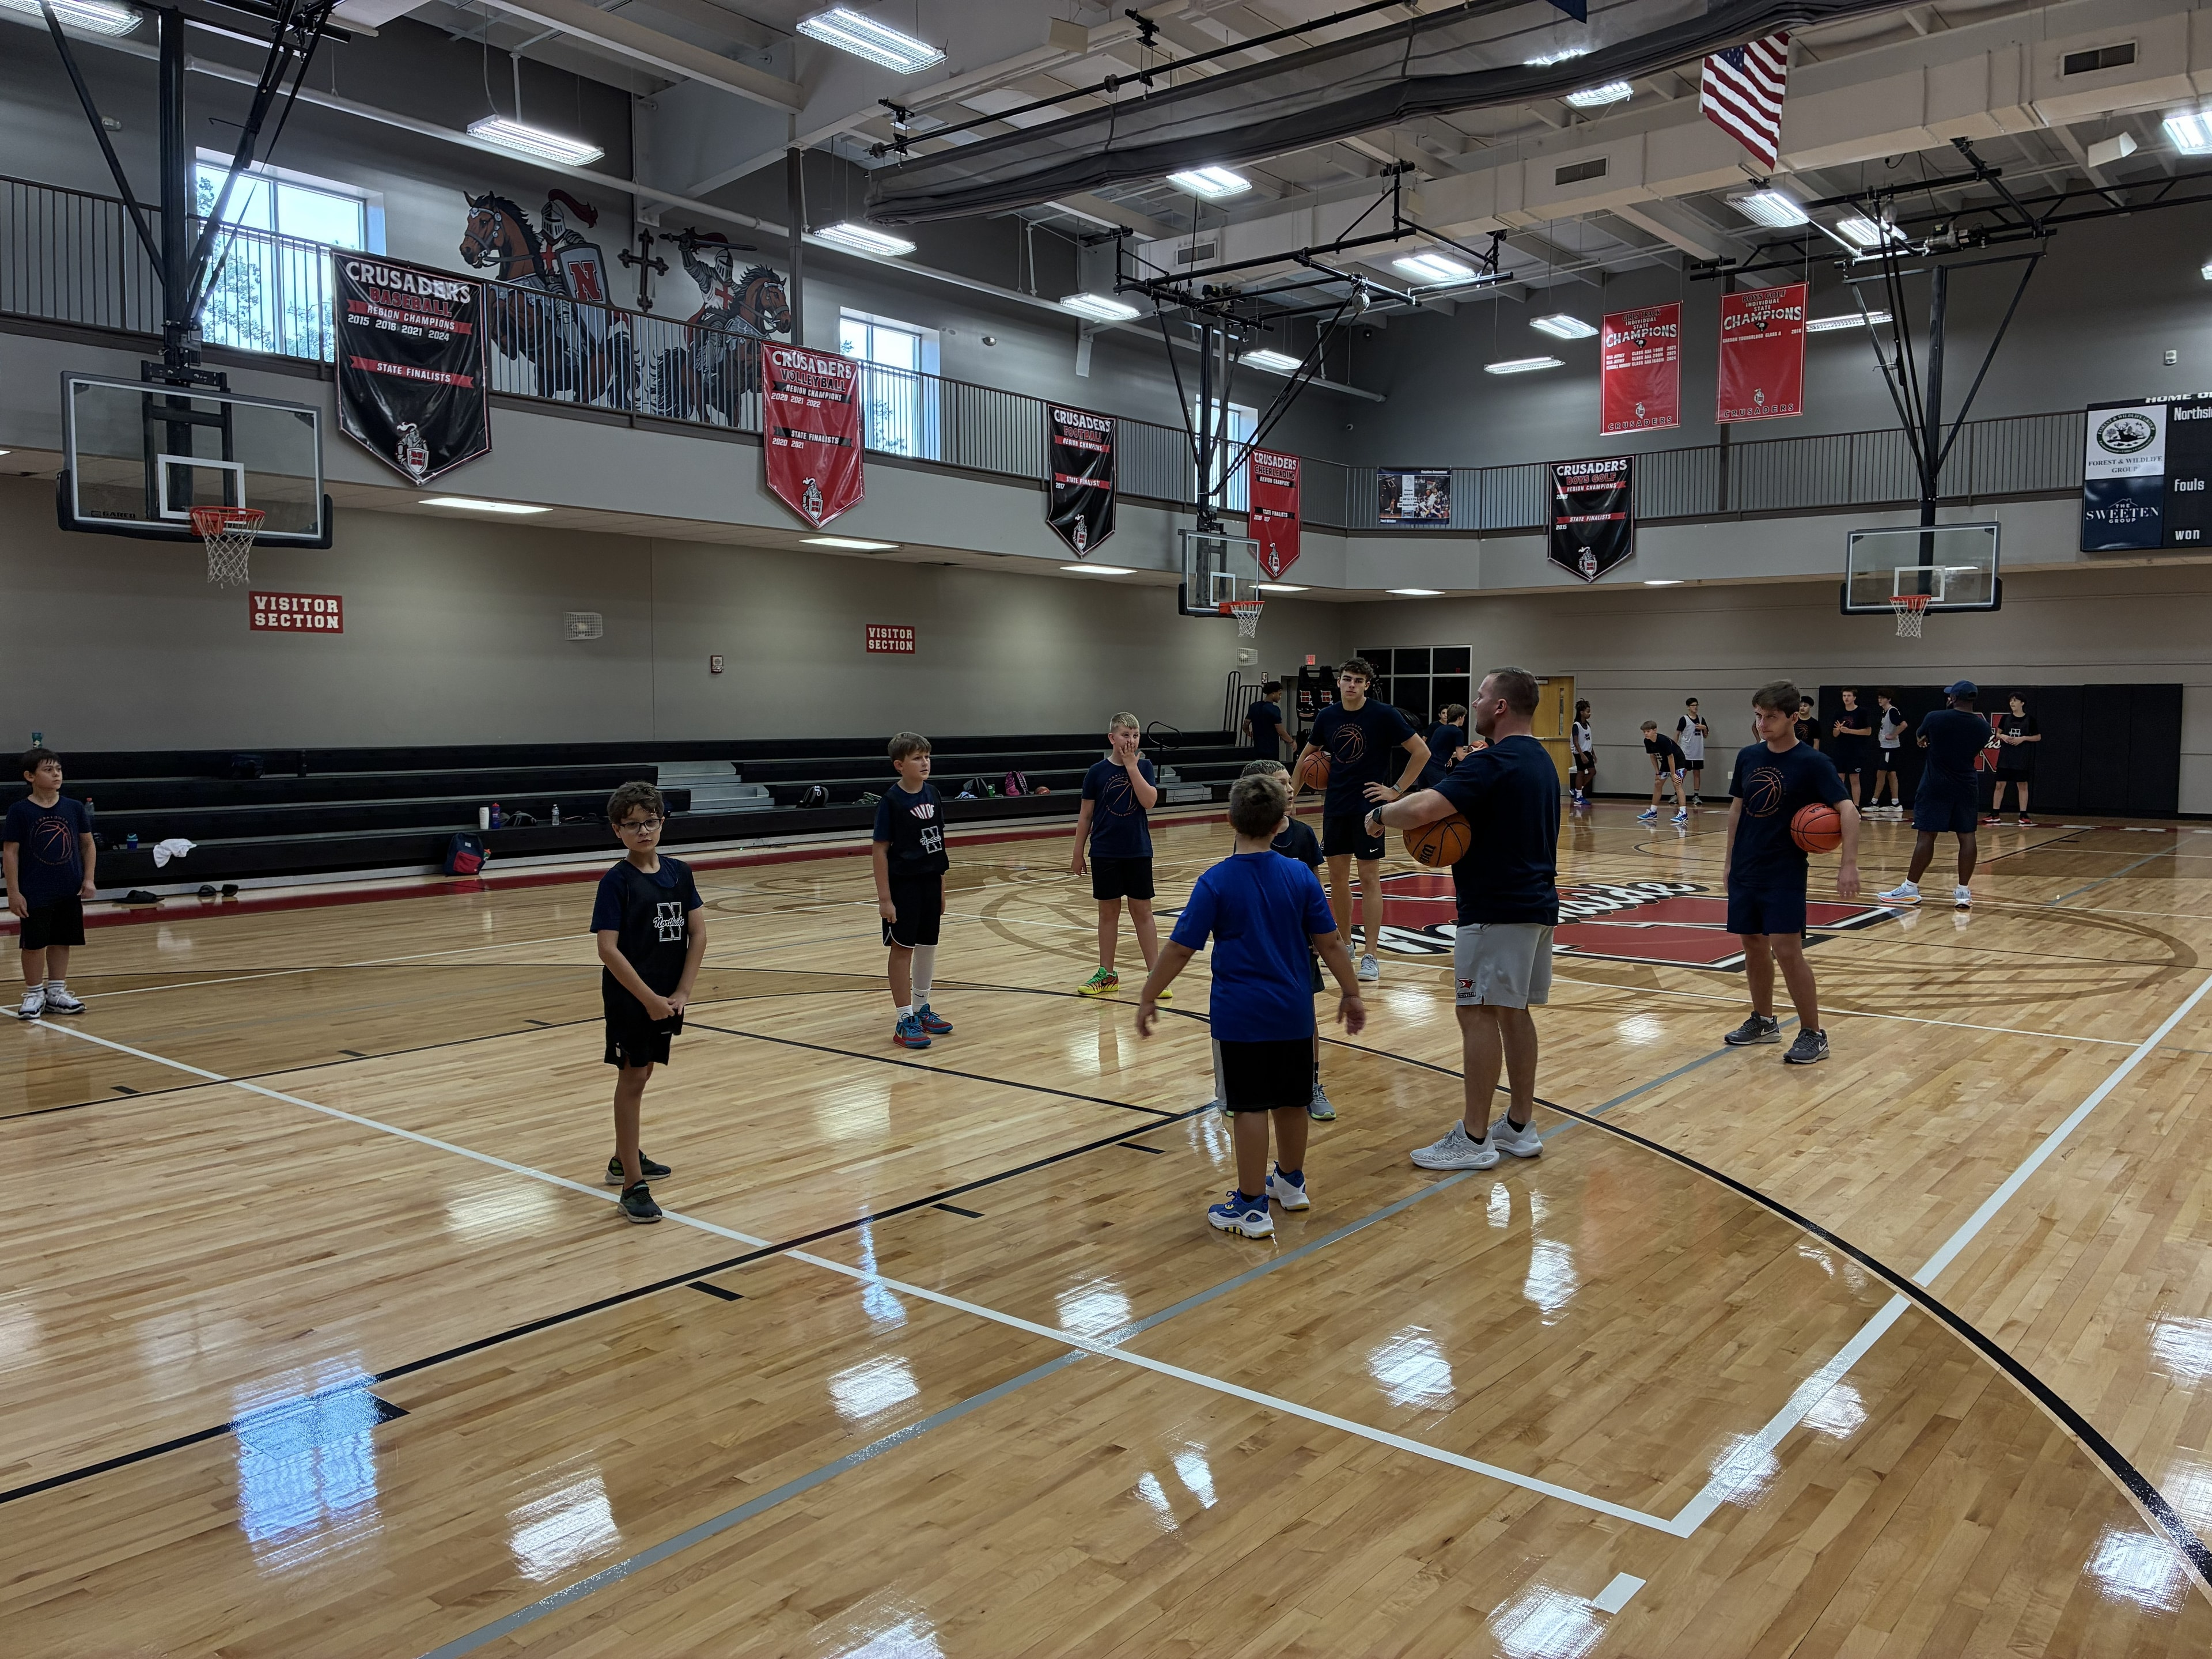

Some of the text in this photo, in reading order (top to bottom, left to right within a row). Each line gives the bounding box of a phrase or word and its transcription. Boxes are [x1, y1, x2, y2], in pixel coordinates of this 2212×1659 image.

[346, 261, 471, 304] CRUSADERS
[569, 260, 604, 302] N
[369, 287, 452, 317] BASEBALL
[1742, 290, 1786, 303] BOYS GOLF
[1745, 298, 1779, 308] INDIVIDUAL
[367, 305, 455, 331] REGION CHAMPIONS
[1622, 308, 1661, 322] GIRLS TRACK
[1626, 317, 1657, 326] INDIVIDUAL
[1724, 306, 1802, 331] CHAMPIONS
[347, 314, 370, 327] 2015
[401, 324, 423, 336] 2021
[428, 329, 450, 342] 2024
[1605, 323, 1677, 348] CHAMPIONS
[377, 363, 451, 382] STATE FINALISTS
[772, 350, 853, 380] CRUSADERS
[780, 368, 846, 392] VOLLEYBALL
[771, 392, 821, 408] 2020 2021 2022
[786, 384, 842, 402] REGION CHAMPIONS
[2145, 393, 2192, 403] HOME
[1724, 404, 1794, 418] CRUSADERS
[2173, 405, 2212, 422] Northsi
[1054, 410, 1111, 433] CRUSADERS
[1608, 415, 1672, 430] CRUSADERS
[791, 430, 839, 445] STATE FINALISTS
[1063, 425, 1103, 443] FOOTBALL
[772, 437, 804, 449] 2020 2021
[1062, 437, 1078, 447] REGION
[1254, 452, 1297, 471] CRUSADERS
[1556, 459, 1628, 476] CRUSADERS
[2126, 456, 2163, 464] WILDLIFE
[1254, 464, 1296, 480] CHEERLEADING
[2111, 465, 2138, 474] GROUP
[1066, 476, 1078, 484] STATE
[1566, 473, 1617, 486] BOYS GOLF
[1586, 483, 1617, 491] CHAMPIONS
[2174, 478, 2205, 492] Fouls
[2085, 506, 2160, 521] SWEETEN
[2175, 529, 2200, 541] won
[254, 596, 339, 613] VISITOR
[255, 612, 339, 629] SECTION
[868, 627, 913, 639] VISITOR
[868, 639, 913, 651] SECTION
